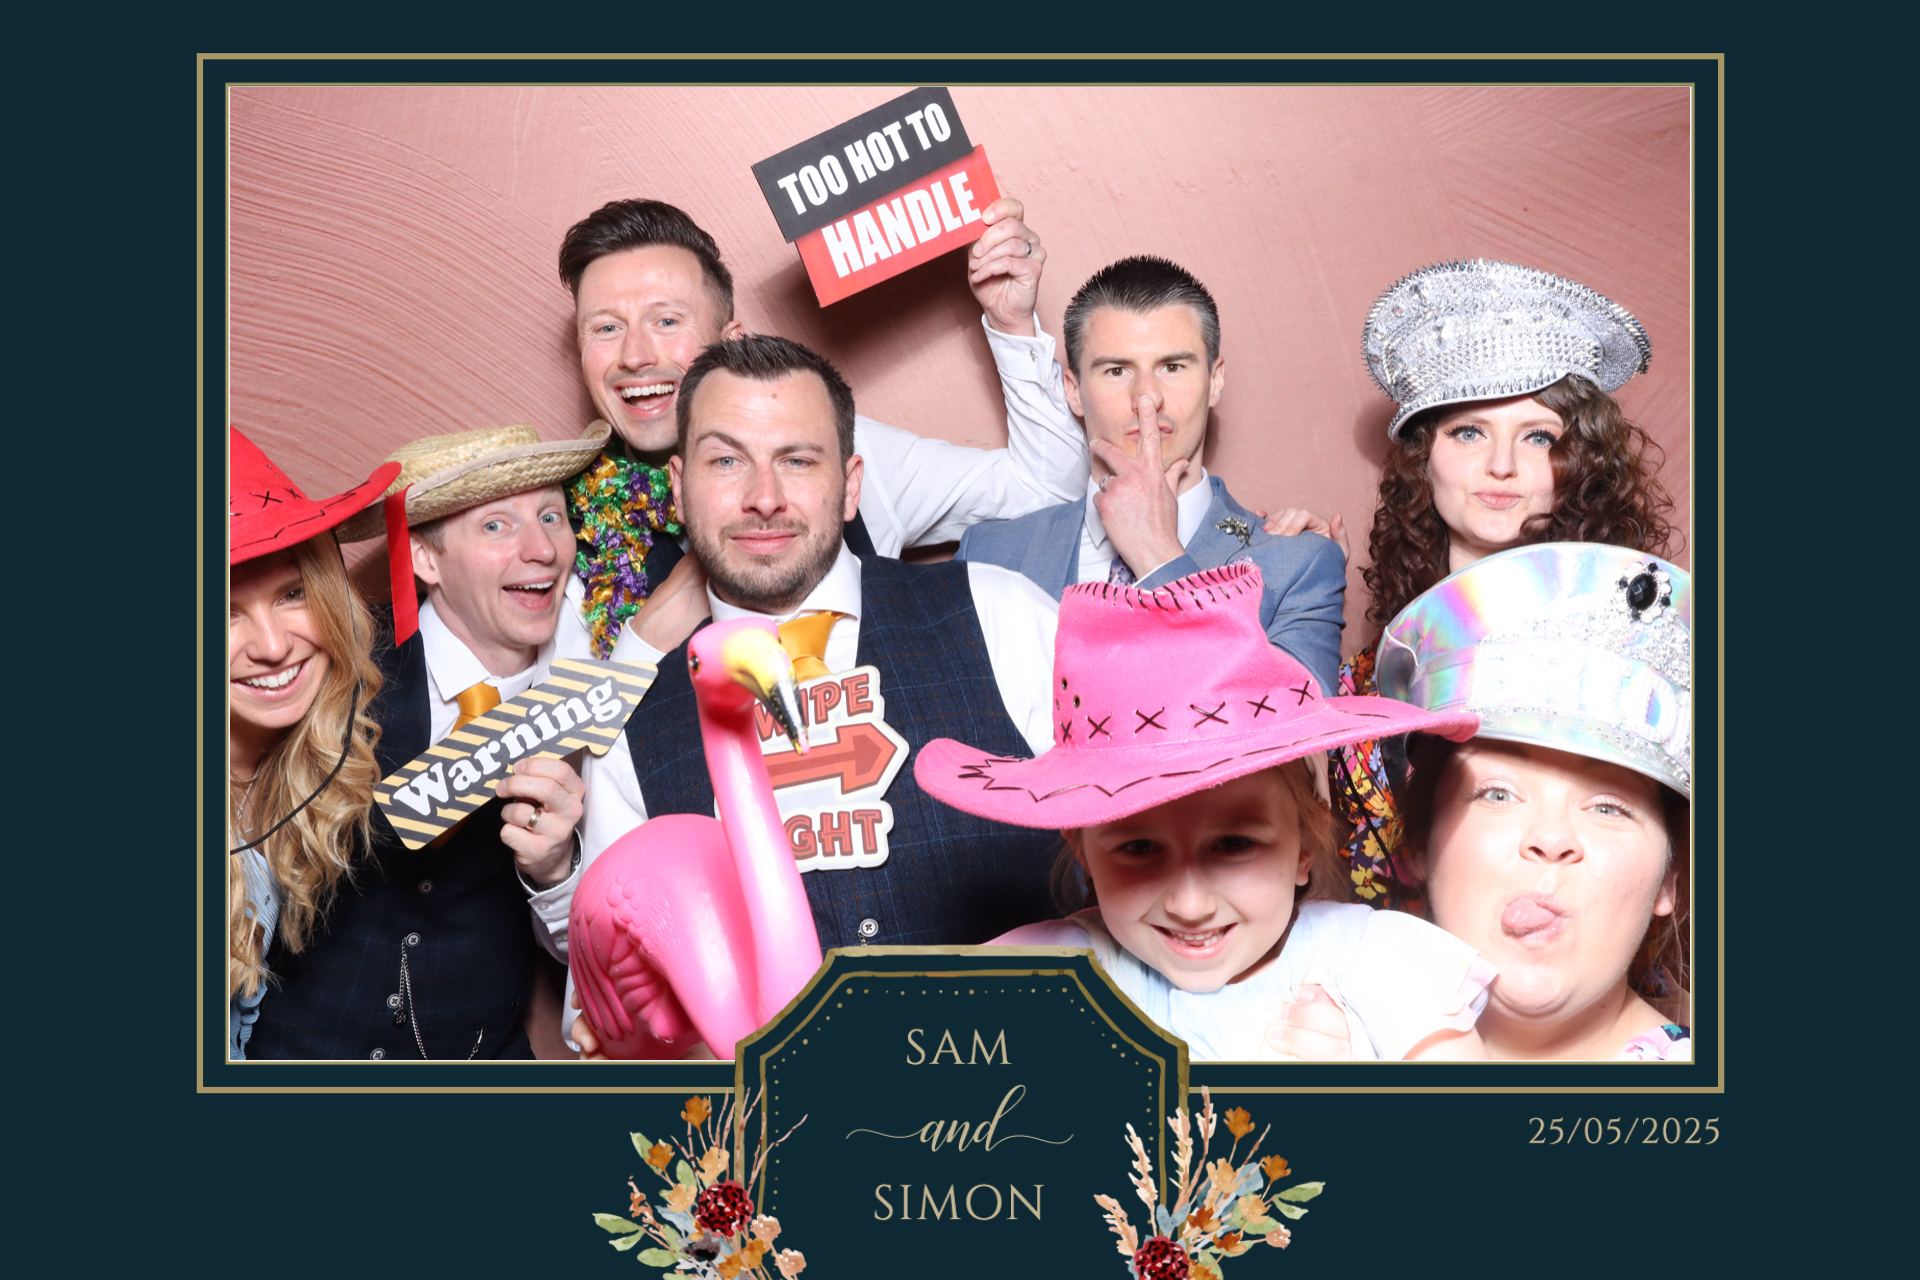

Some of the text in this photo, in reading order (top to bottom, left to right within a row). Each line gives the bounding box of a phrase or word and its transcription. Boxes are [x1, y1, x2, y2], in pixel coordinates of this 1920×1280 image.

[777, 102, 952, 215] TOO HOT TO
[821, 170, 983, 279] HANDLE
[393, 679, 623, 816] Warning
[1466, 640, 1690, 755] BRID
[782, 808, 883, 861] GHT
